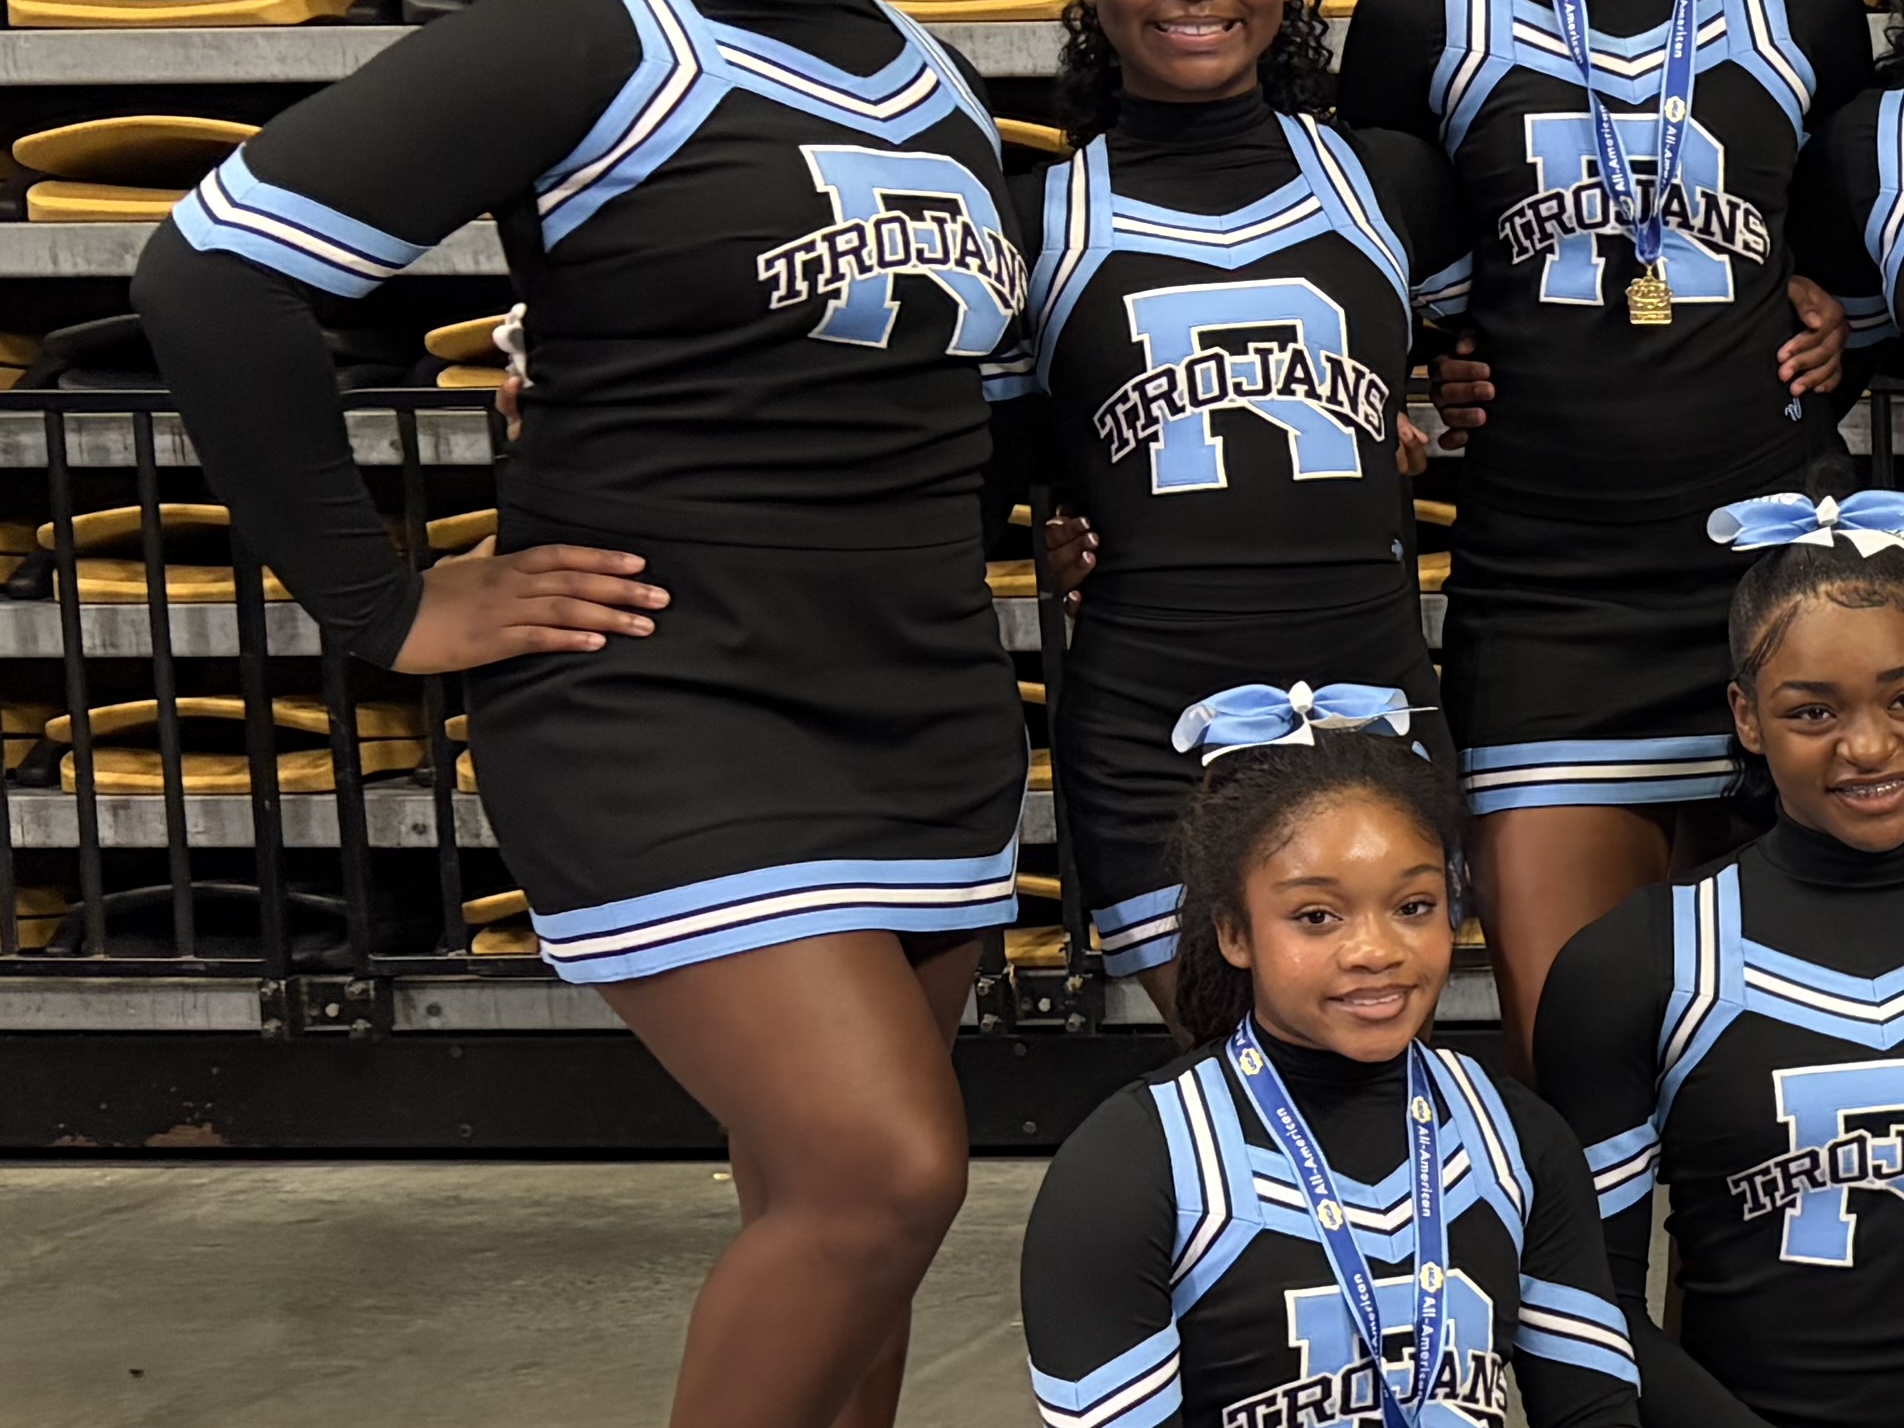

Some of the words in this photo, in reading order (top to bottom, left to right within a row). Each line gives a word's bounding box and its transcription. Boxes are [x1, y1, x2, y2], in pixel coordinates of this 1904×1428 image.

[800, 144, 1016, 356] R
[1497, 174, 1770, 266] TROJANS
[1093, 341, 1390, 464] TROJANS
[1123, 277, 1363, 495] R
[1276, 1107, 1329, 1195] All-American
[1417, 1125, 1434, 1217] All-American
